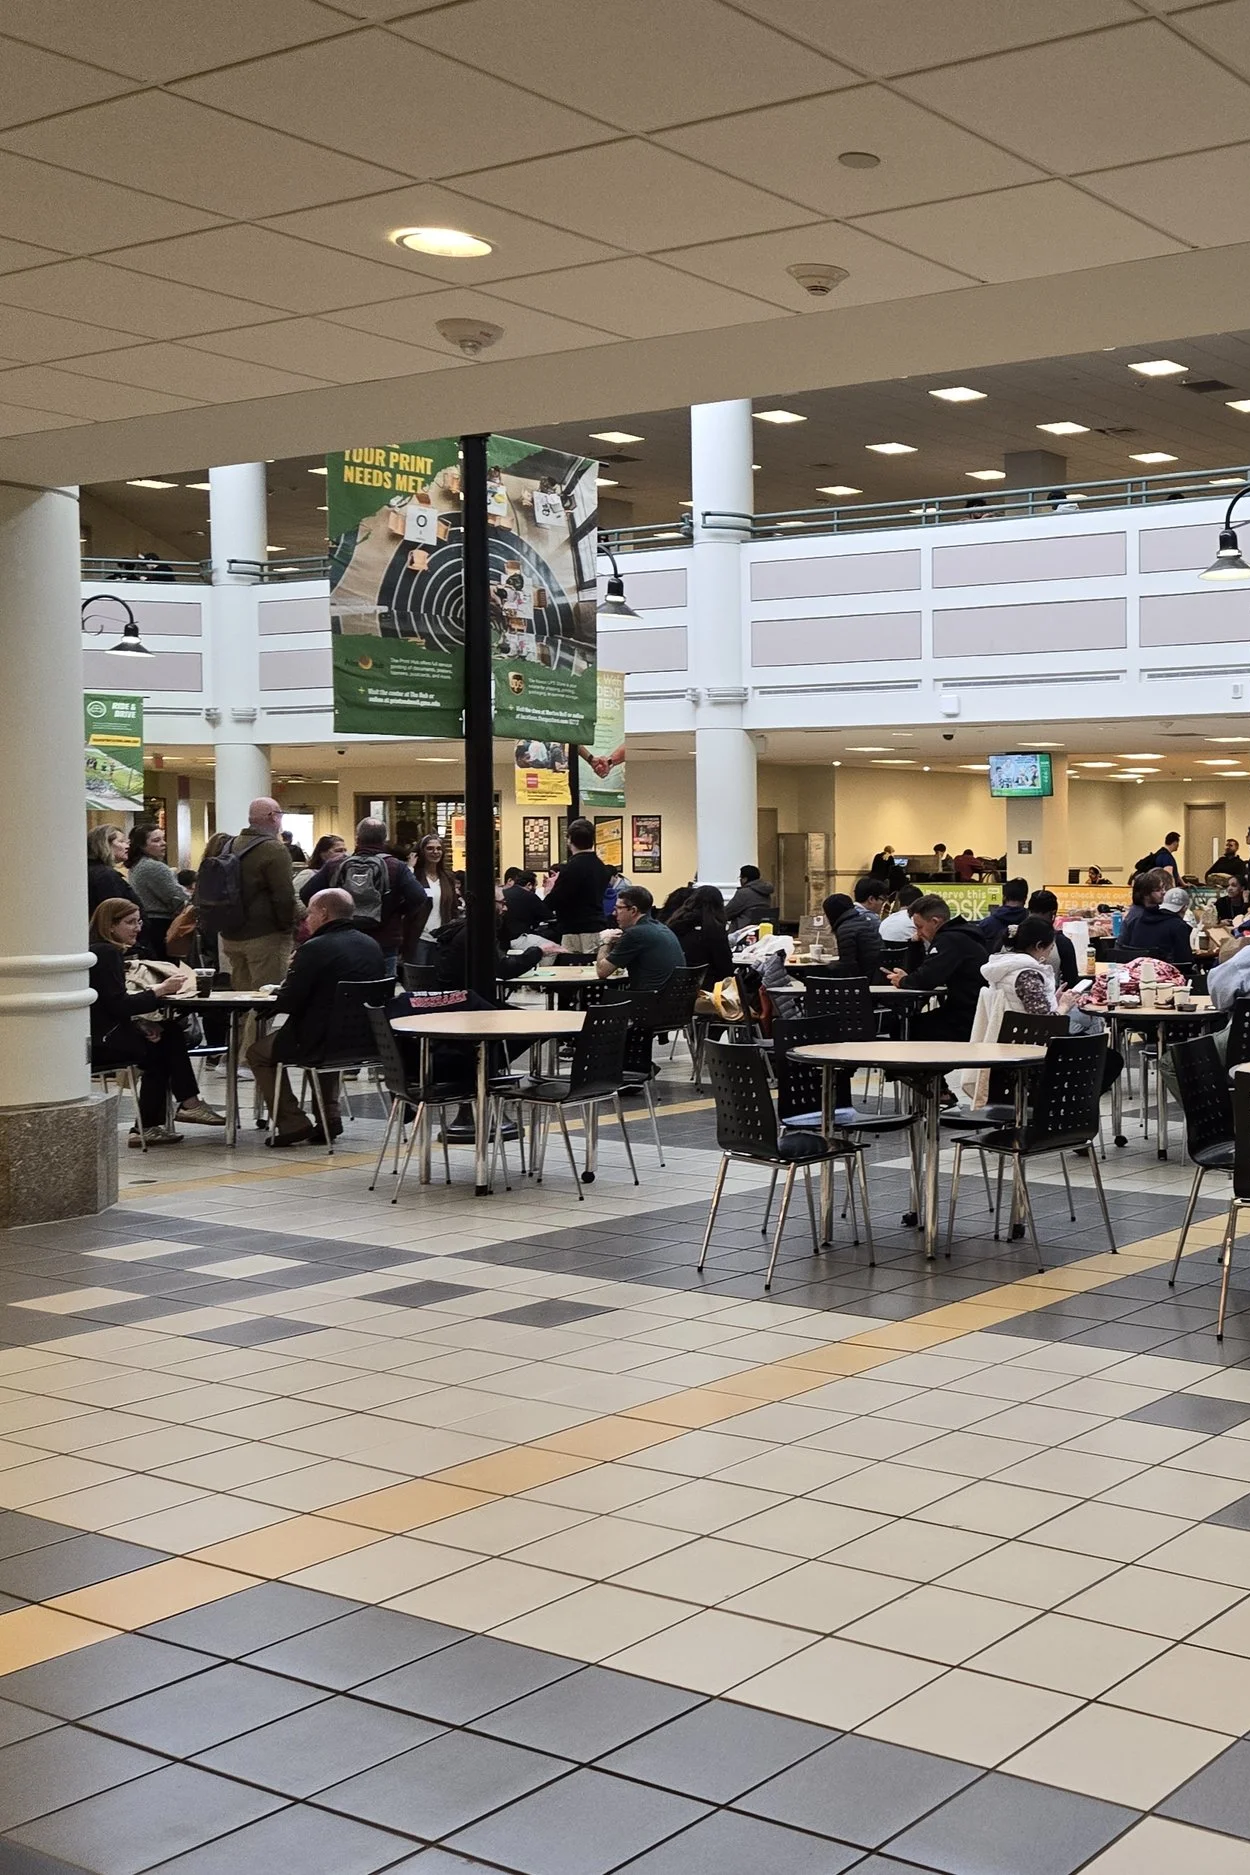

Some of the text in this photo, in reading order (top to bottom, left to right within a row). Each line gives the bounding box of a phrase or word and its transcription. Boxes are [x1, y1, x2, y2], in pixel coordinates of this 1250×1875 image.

[389, 451, 434, 475] PRINT
[343, 465, 392, 489] NEEDS
[597, 686, 622, 699] DENT
[967, 889, 987, 899] this
[946, 899, 987, 922] OSK
